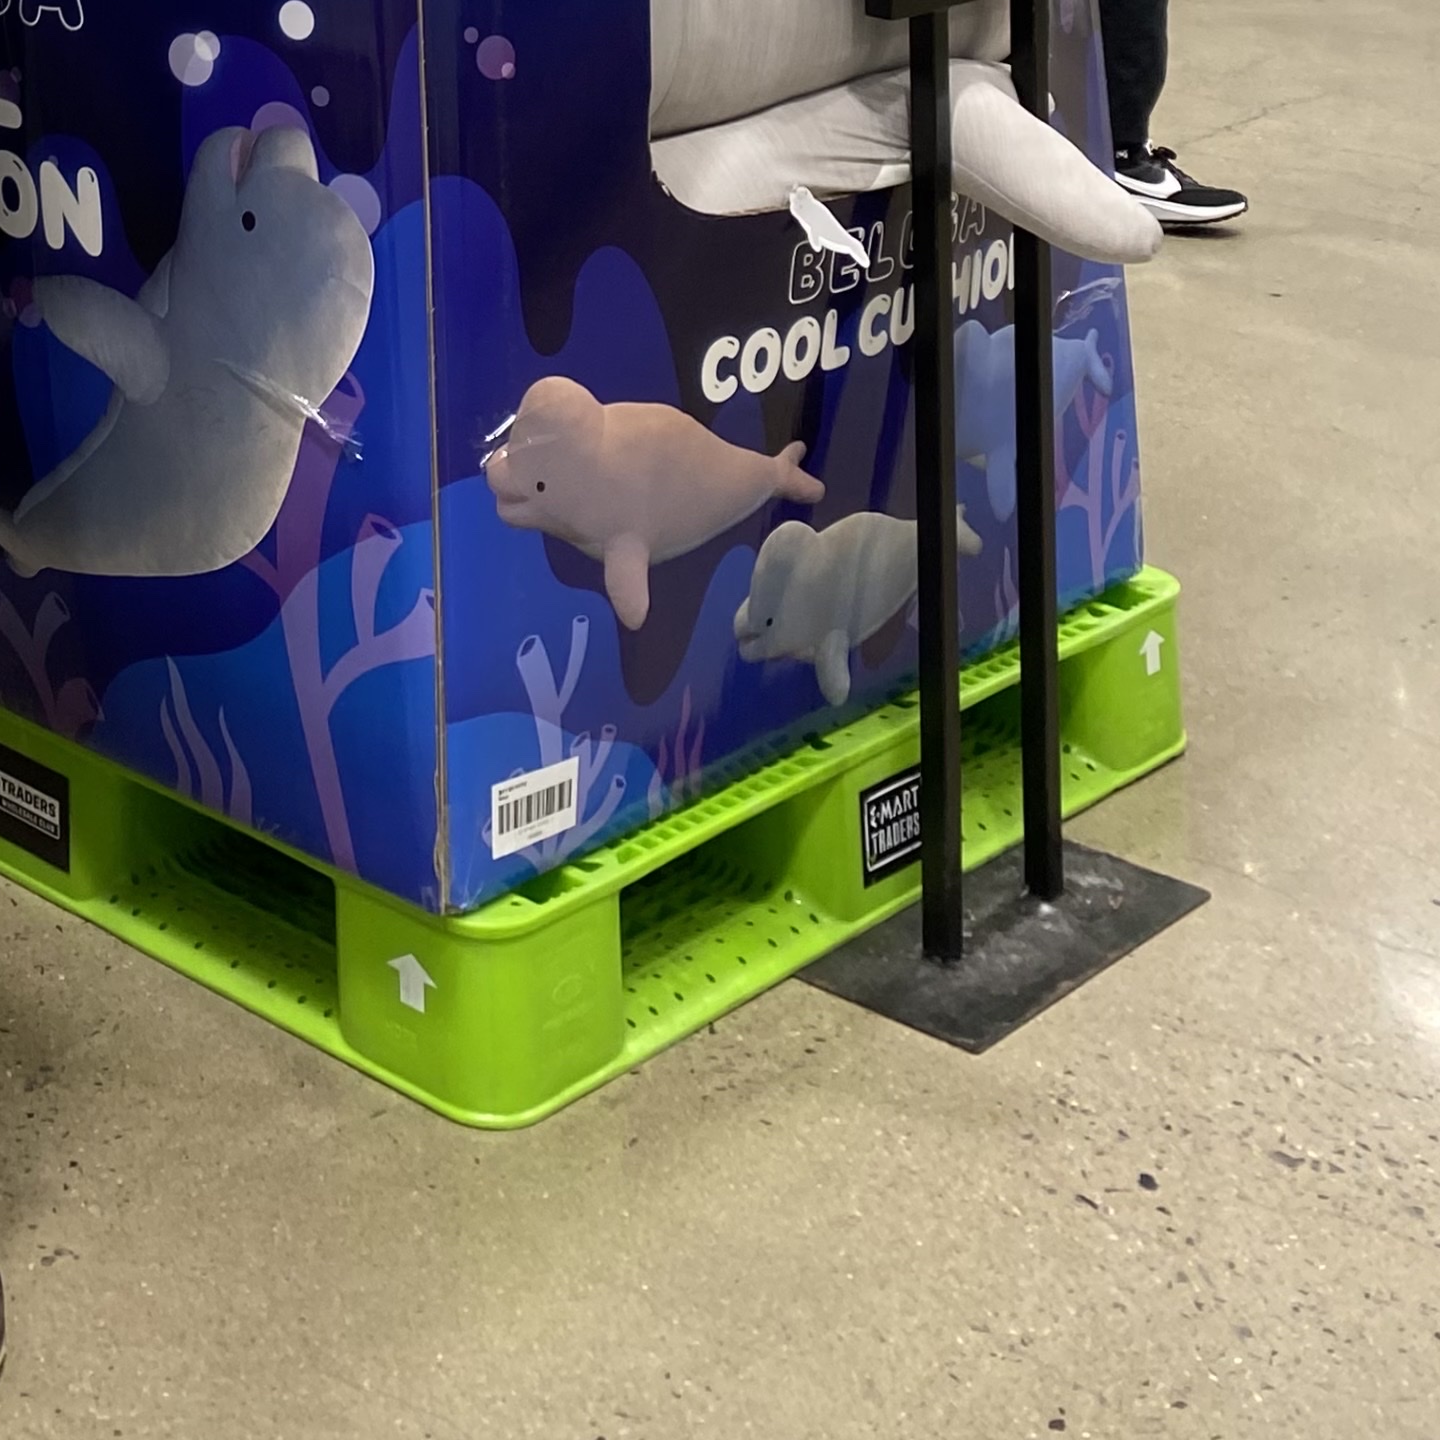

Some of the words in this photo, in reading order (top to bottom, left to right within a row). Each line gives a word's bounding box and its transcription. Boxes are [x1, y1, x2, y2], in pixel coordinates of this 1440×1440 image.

[701, 309, 850, 403] COOL
[0, 777, 56, 818] TRADERS
[871, 812, 920, 860] TRADERS
